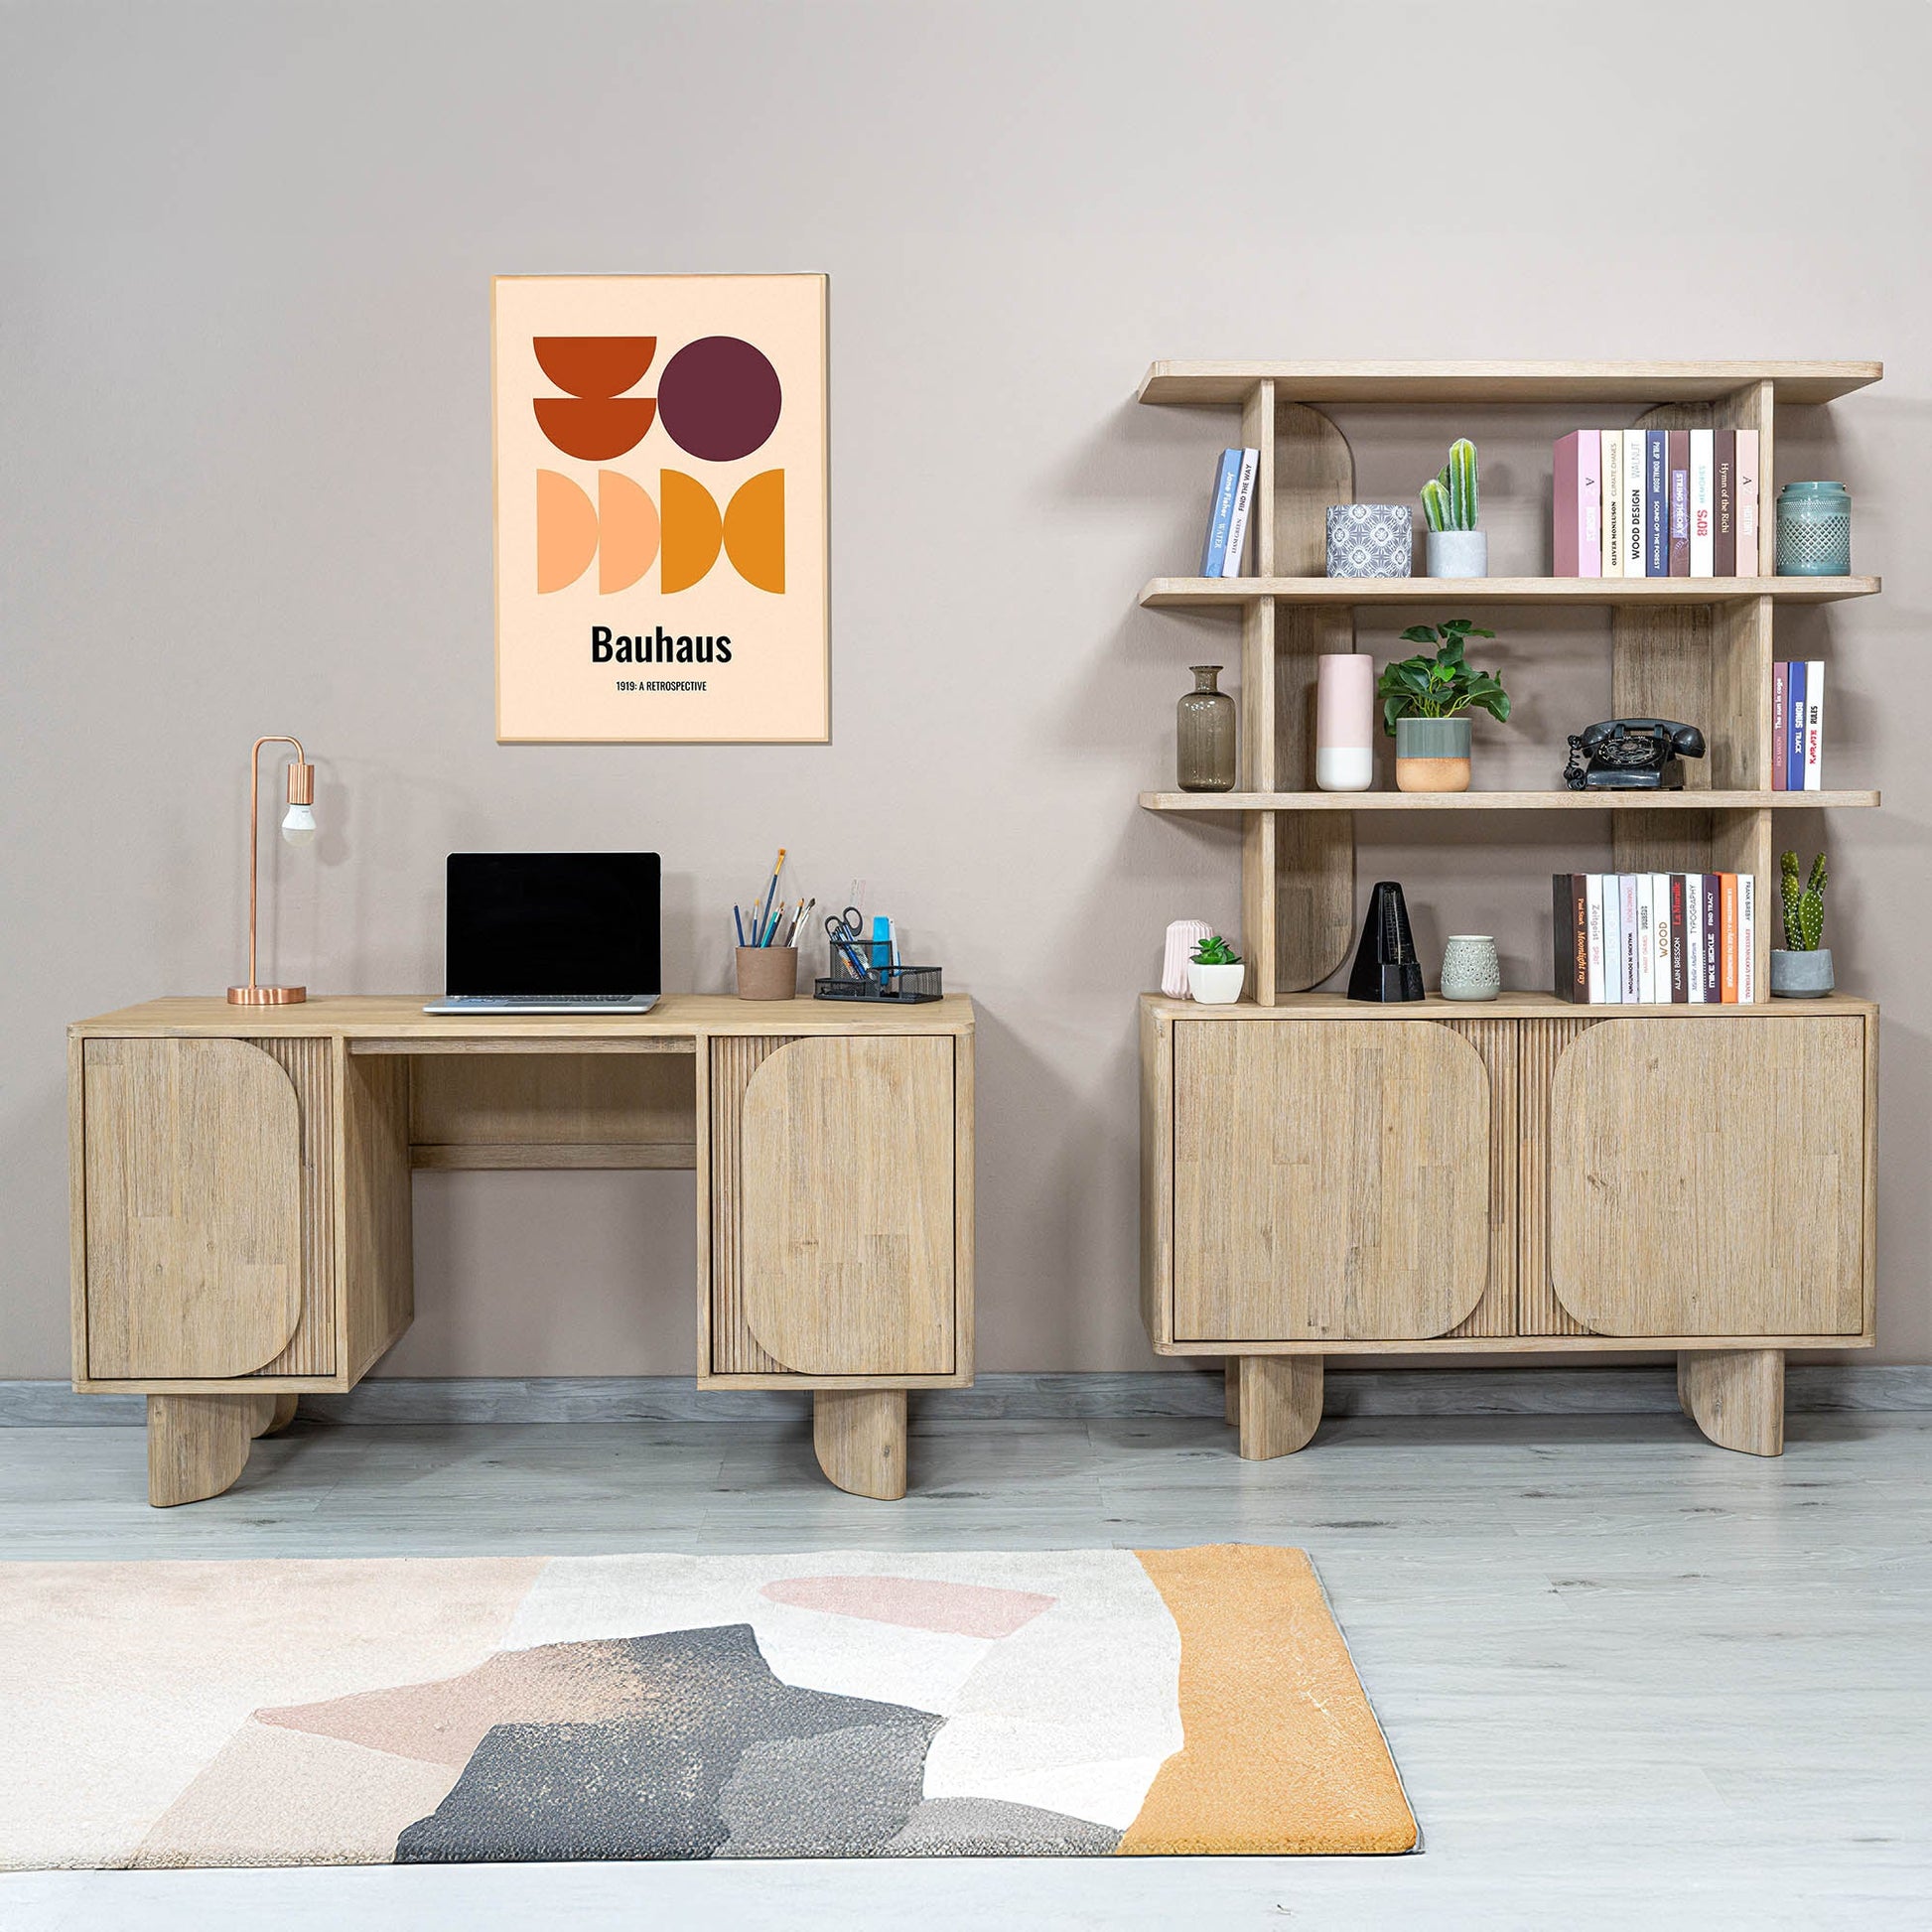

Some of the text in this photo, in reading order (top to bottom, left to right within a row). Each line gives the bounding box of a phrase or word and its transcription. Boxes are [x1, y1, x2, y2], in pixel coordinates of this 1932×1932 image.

[1675, 473, 1683, 502] STRING
[1720, 463, 1729, 488] Hymn
[1631, 443, 1640, 560] WOOD DESIGN WALNUT
[1722, 488, 1729, 497] of
[1214, 472, 1235, 549] Jane Fisher WATER
[1675, 503, 1683, 534] THEORY
[1697, 509, 1708, 536] 80'S
[1654, 523, 1660, 532] OF
[592, 625, 732, 663] Bauhaus
[616, 681, 707, 691] 1919: A RETROSPECTIVE
[1795, 701, 1803, 729] BONUS
[1809, 730, 1818, 764] KARATE
[1590, 904, 1600, 941] Zeitgeist
[1673, 914, 1682, 926] La
[1577, 930, 1586, 969] Moonlight
[1658, 922, 1668, 958] WOOD
[1577, 969, 1586, 984] ray
